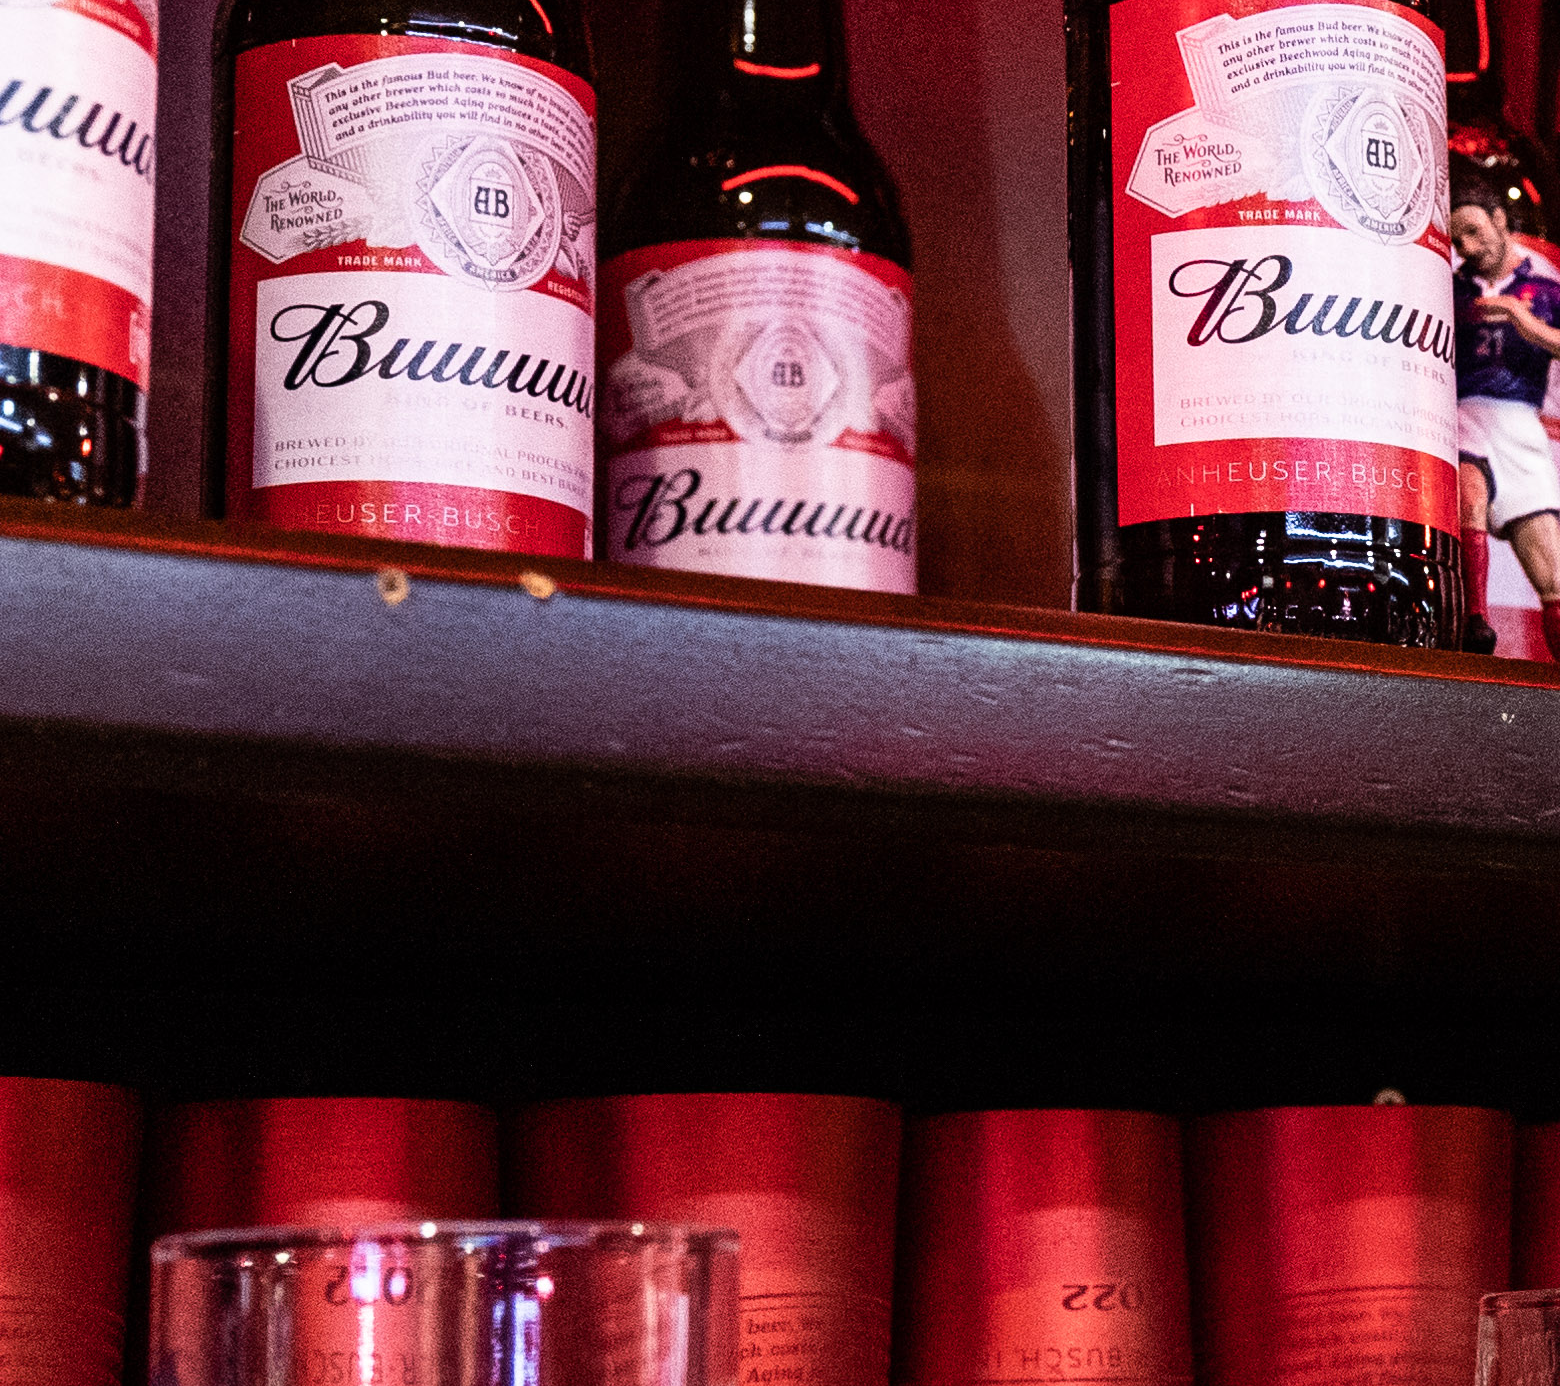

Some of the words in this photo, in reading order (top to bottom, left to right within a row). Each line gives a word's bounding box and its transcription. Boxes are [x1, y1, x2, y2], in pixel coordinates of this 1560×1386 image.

[1218, 40, 1240, 55] This
[1243, 35, 1252, 45] is
[1255, 30, 1272, 41] the
[1275, 23, 1313, 37] famous
[1318, 22, 1339, 30] Bud
[1222, 54, 1244, 68] any
[1246, 44, 1275, 58] other
[1279, 37, 1316, 49] brewer
[1320, 34, 1349, 43] which
[1353, 37, 1376, 46] costs
[1227, 58, 1275, 80] exclusive
[1279, 49, 1339, 63] Beechwood
[1230, 80, 1250, 94] and
[1263, 62, 1324, 82] drinkability
[1328, 63, 1346, 71] you
[1349, 63, 1366, 71] will
[325, 88, 346, 103] This
[349, 84, 358, 95] is
[361, 79, 379, 90] the
[381, 72, 423, 87] famous
[427, 71, 449, 80] Bud
[328, 104, 350, 116] any
[352, 92, 381, 108] other
[385, 86, 425, 98] brewer
[428, 84, 461, 92] which
[465, 86, 491, 96] costs
[332, 105, 381, 129] exclusive
[385, 97, 448, 111] Beechwood
[335, 127, 356, 142] and
[358, 123, 365, 133] a
[367, 111, 432, 129] drinkability
[436, 110, 455, 120] you
[459, 111, 478, 120] will
[480, 112, 501, 125] find
[1155, 148, 1180, 167] THE
[1182, 143, 1234, 160] WORLD
[1164, 162, 1241, 188] RENOWNED
[265, 195, 285, 214] THE
[288, 190, 337, 205] WORLD
[1238, 210, 1279, 221] TRADE
[1284, 210, 1321, 222] MARK
[270, 208, 343, 233] RENOWNED
[338, 255, 377, 267] TRADE
[384, 255, 422, 267] MARK
